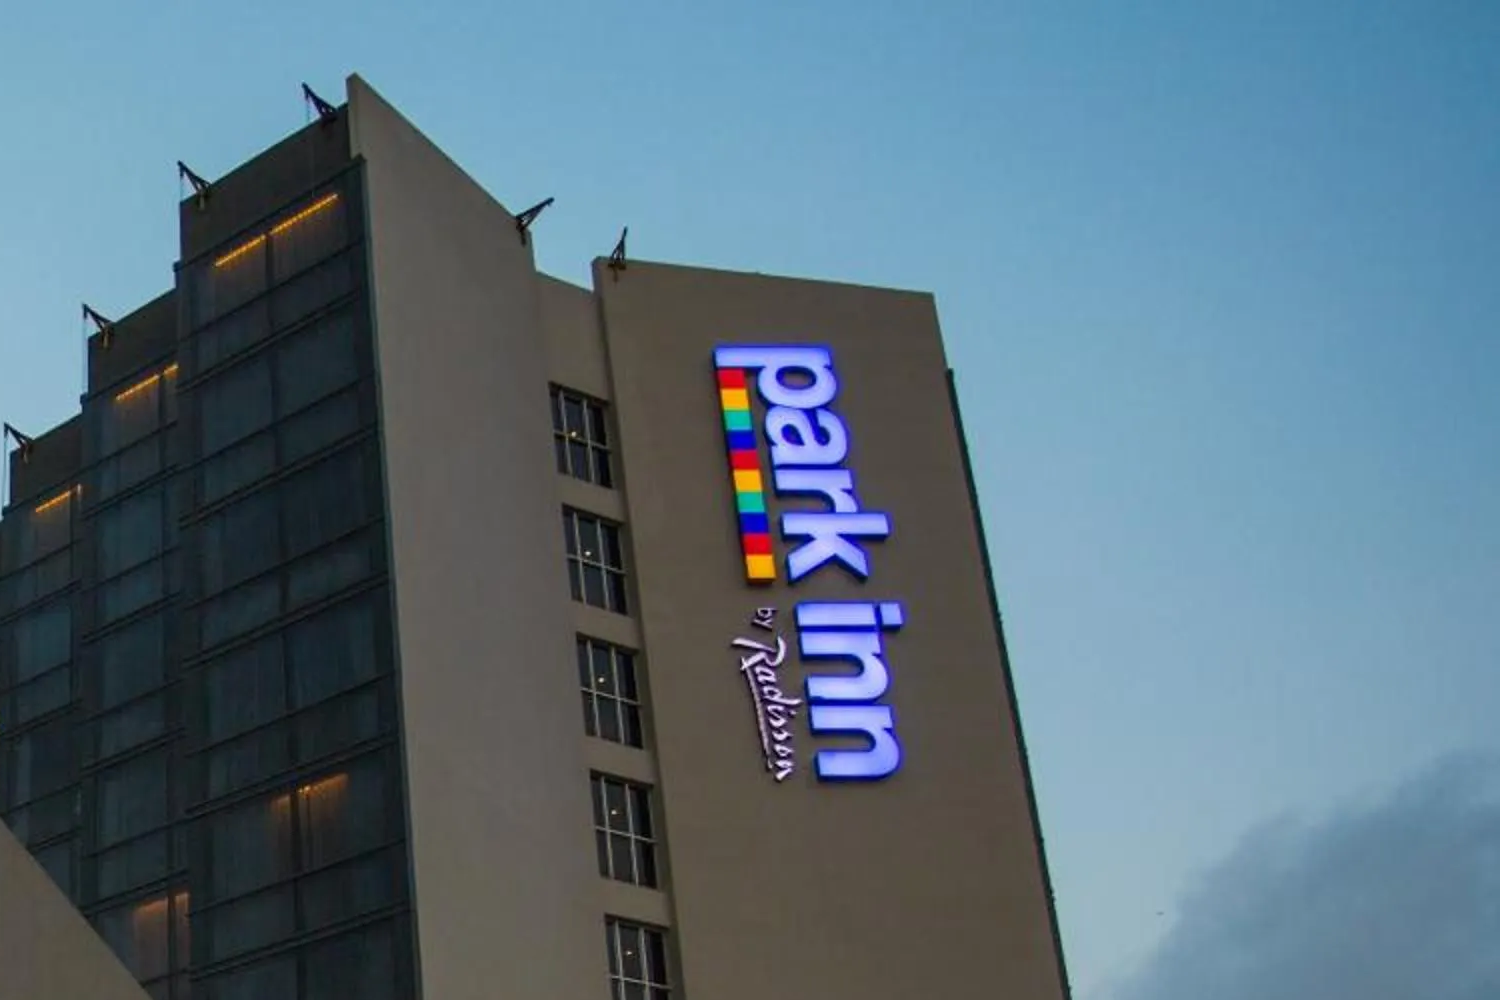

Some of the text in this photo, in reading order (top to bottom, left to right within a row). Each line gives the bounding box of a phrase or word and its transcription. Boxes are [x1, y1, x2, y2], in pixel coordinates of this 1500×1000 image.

[712, 345, 904, 781] park inn
[731, 607, 802, 783] by Radisson
